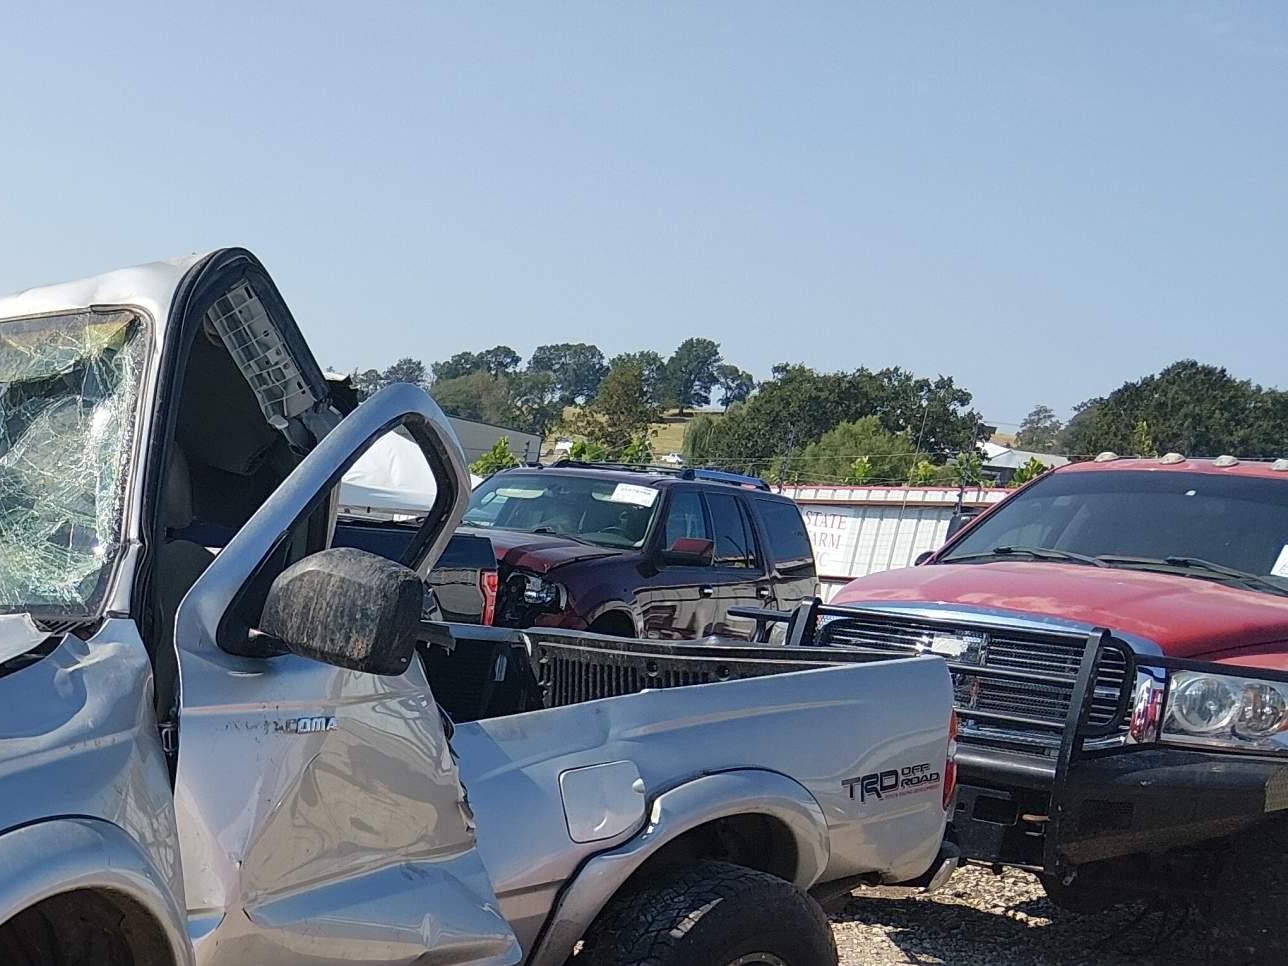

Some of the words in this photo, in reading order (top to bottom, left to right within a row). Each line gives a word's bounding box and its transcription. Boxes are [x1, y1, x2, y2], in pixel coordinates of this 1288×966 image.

[805, 510, 848, 529] STATE
[808, 530, 842, 550] ARM
[900, 763, 931, 777] OFF
[841, 769, 899, 804] TRD
[900, 772, 941, 789] ROAD
